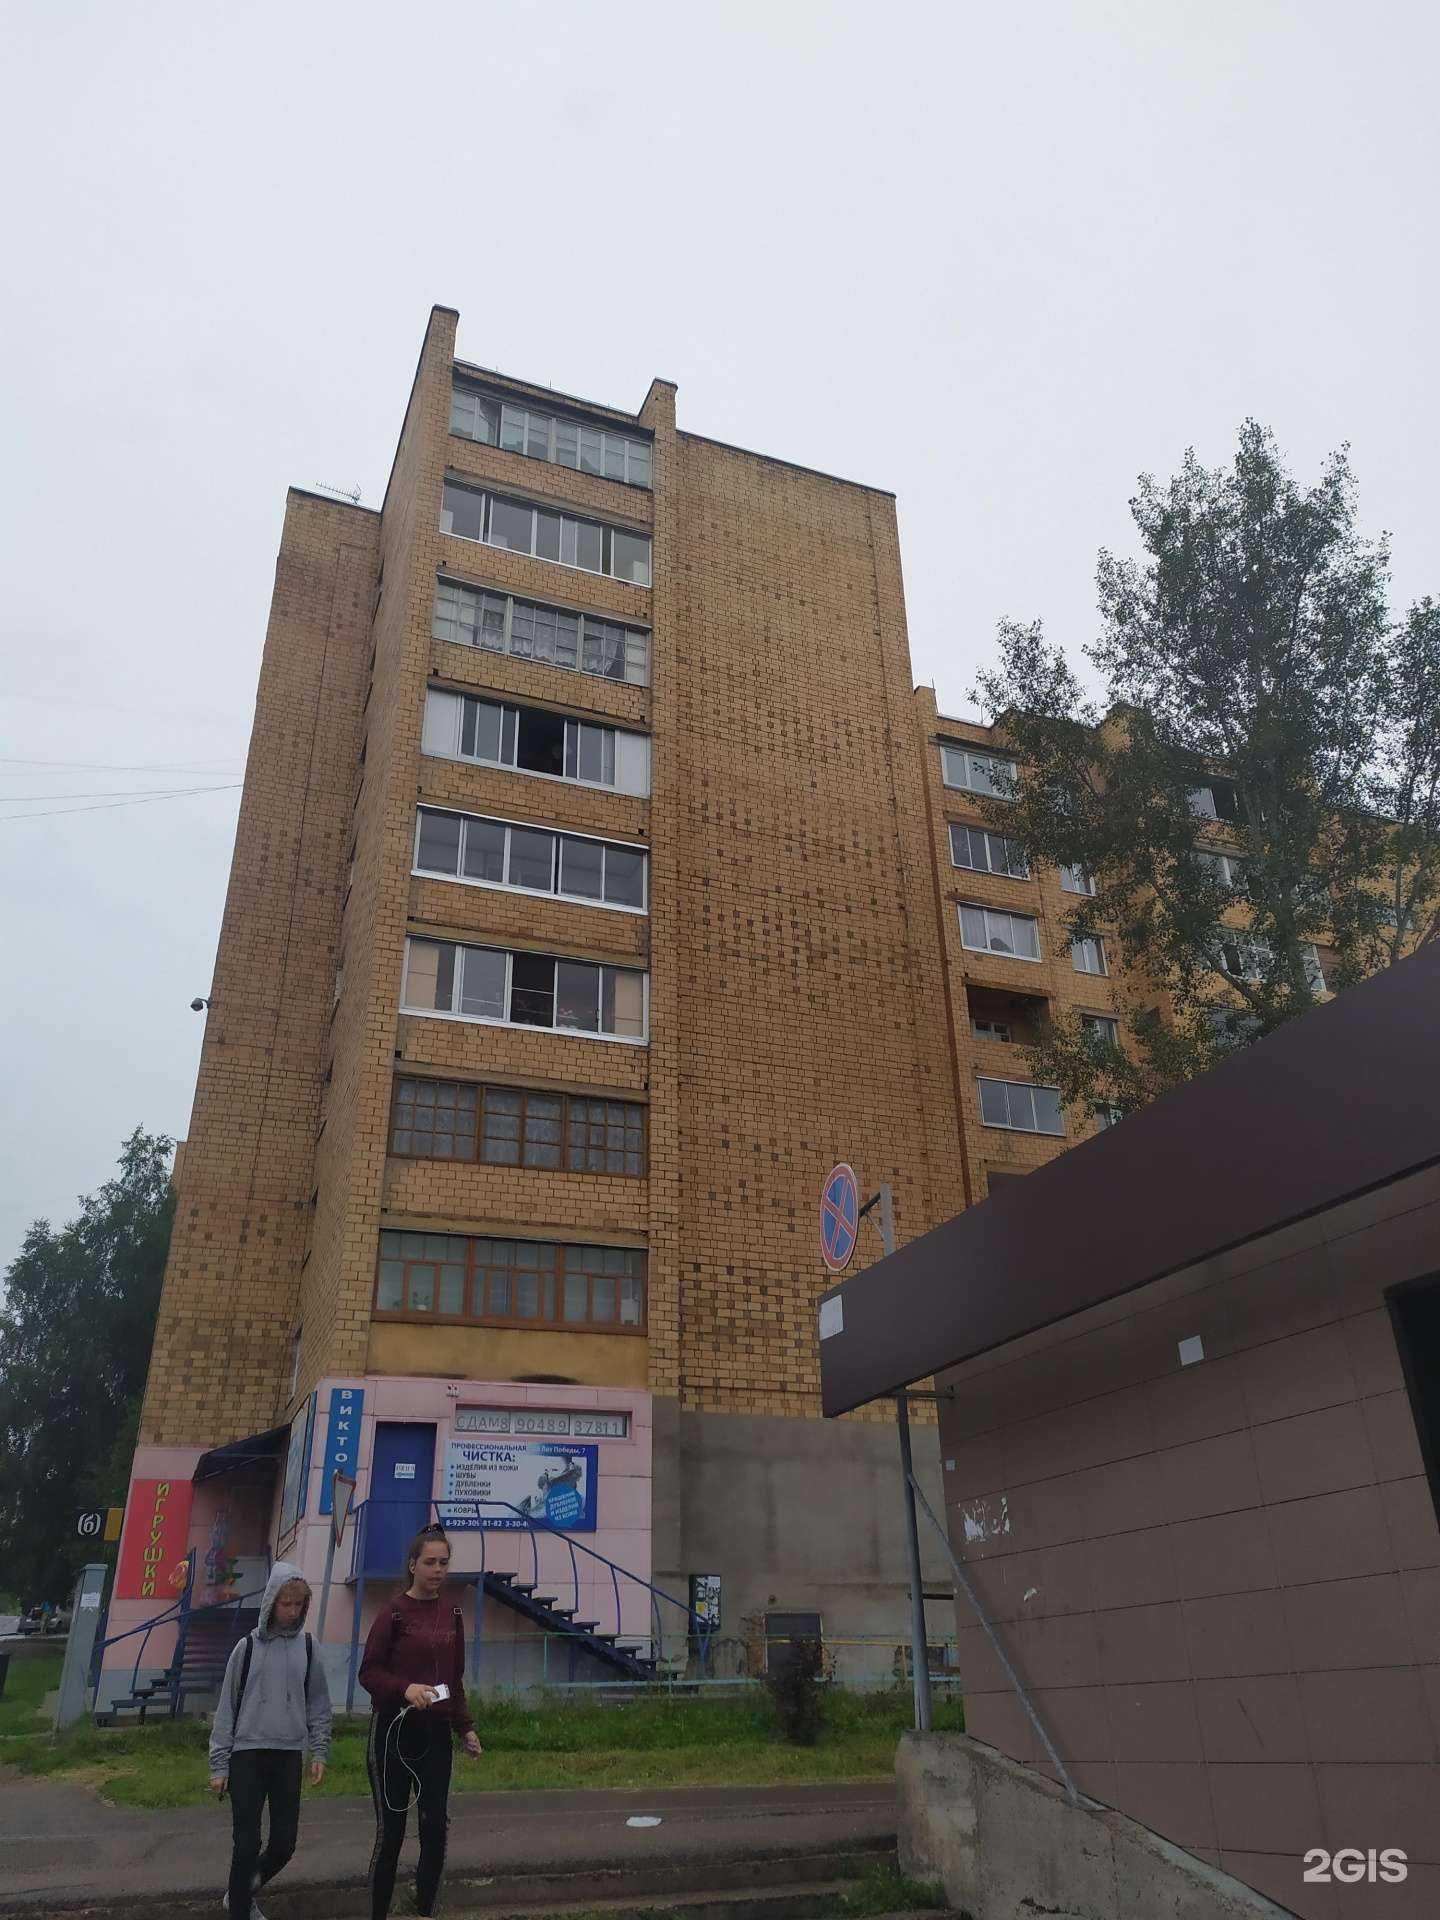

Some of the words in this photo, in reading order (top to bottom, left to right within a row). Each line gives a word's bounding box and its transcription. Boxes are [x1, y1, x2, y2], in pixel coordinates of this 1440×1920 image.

[451, 1442, 527, 1451] ПРОФЕССИОНАЛЬНАЯ
[462, 1451, 516, 1462] ЧИСТКА:
[455, 1480, 491, 1488] ДУБЛЕНКИ
[141, 1482, 170, 1596] ИГРУШКИ
